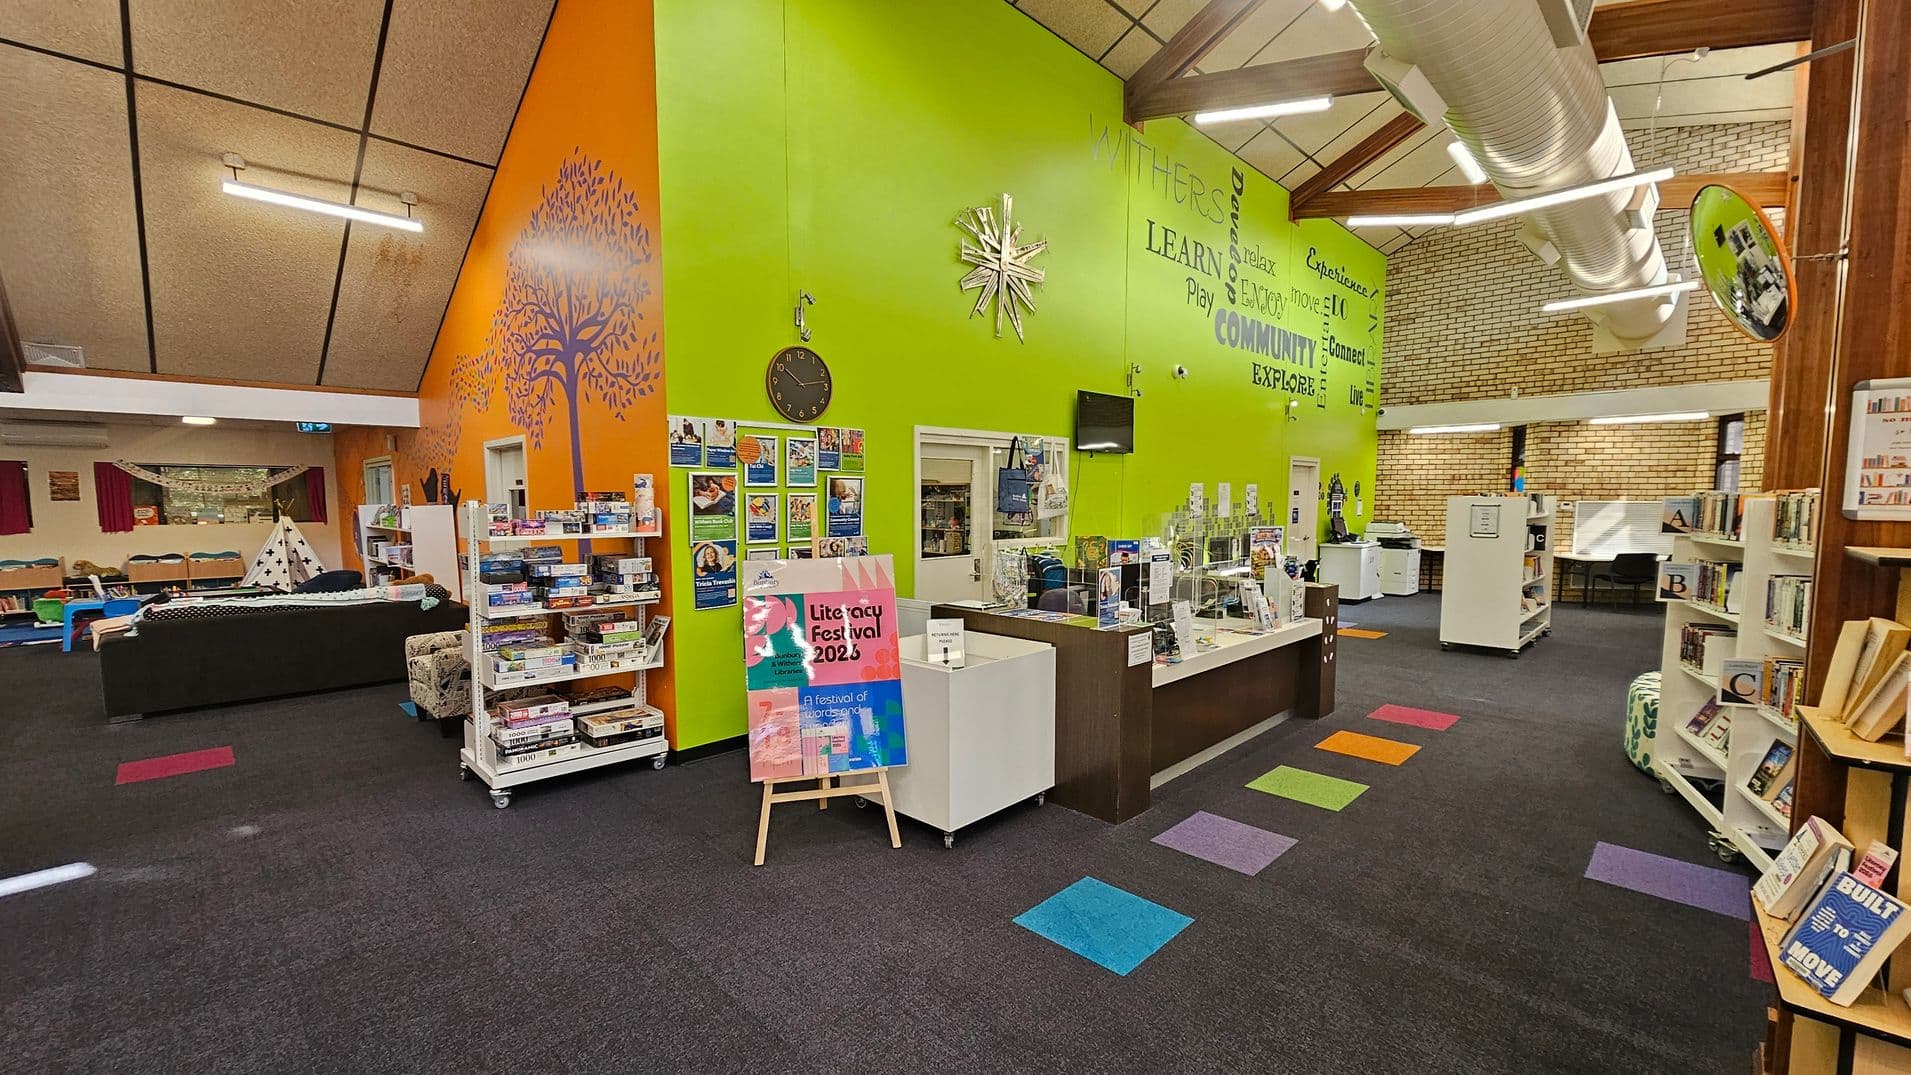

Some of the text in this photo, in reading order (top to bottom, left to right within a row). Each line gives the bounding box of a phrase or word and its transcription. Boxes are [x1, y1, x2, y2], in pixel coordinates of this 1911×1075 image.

[1089, 112, 1225, 225] WITHERS
[1225, 166, 1244, 305] Develop
[1146, 218, 1223, 280] LEARN
[1243, 244, 1277, 277] relax
[1186, 276, 1214, 318] Play
[1241, 279, 1288, 320] ENJOY
[1291, 285, 1320, 314] move
[1332, 294, 1349, 321] DO
[1214, 307, 1317, 369] COMMUNITY
[786, 353, 792, 362] 11
[796, 351, 805, 360] 12
[811, 356, 815, 365] 1
[1316, 296, 1331, 410] Entertain
[1328, 335, 1366, 367] Connect
[776, 363, 785, 372] 10
[820, 369, 825, 377] 2
[772, 377, 778, 386] 9
[823, 383, 829, 391] 3
[1252, 362, 1315, 397] EXPLORE
[776, 392, 782, 401] 8
[1349, 384, 1364, 407] Live
[787, 404, 792, 412] 7
[799, 409, 804, 418] 6
[811, 406, 817, 415] 5
[1669, 509, 1690, 528] A
[1536, 534, 1545, 543] C
[1668, 573, 1688, 593] B
[810, 604, 883, 621] Literacy
[811, 620, 882, 642] Festival
[588, 654, 606, 663] 1000
[813, 643, 861, 663] 2026
[1729, 672, 1757, 697] C
[804, 690, 868, 706] A festival of
[516, 753, 536, 764] 1000
[1836, 876, 1899, 920] BUILT
[1833, 923, 1850, 939] TO
[1787, 940, 1843, 988] MOVE
